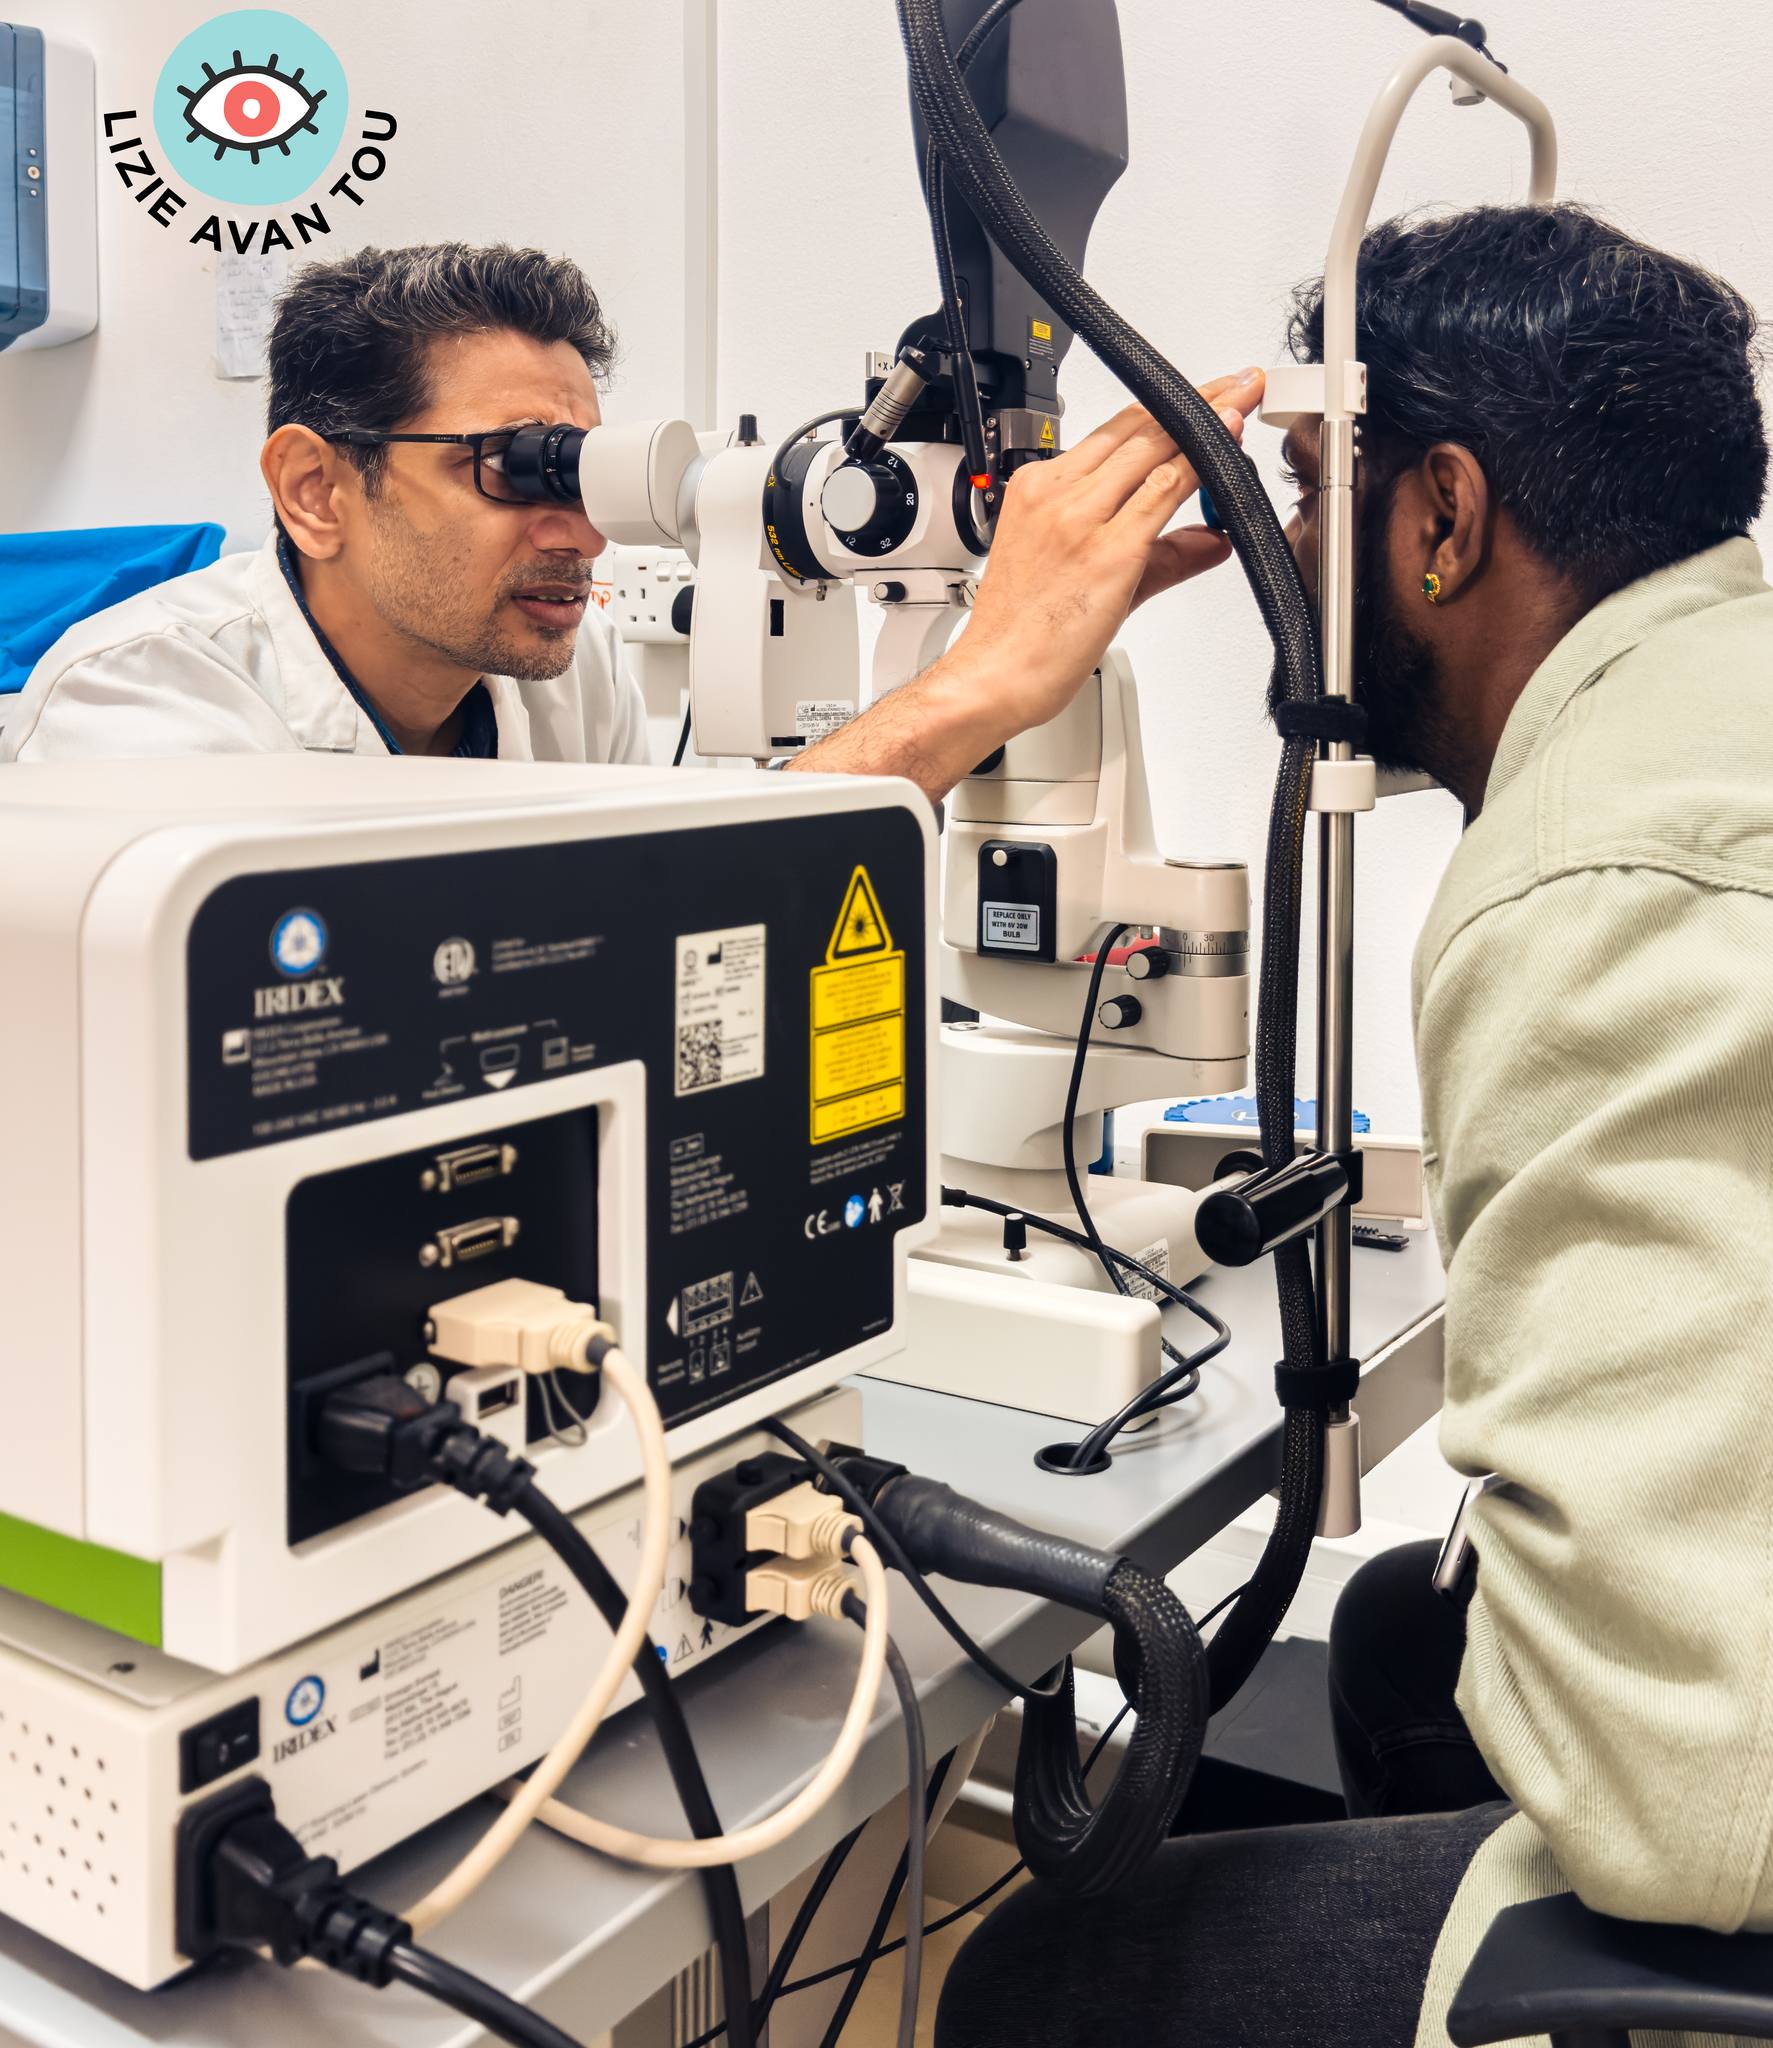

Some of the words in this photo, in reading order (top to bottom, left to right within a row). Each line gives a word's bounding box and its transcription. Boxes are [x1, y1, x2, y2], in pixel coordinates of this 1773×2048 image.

[887, 455, 899, 468] 12
[906, 492, 915, 506] 20
[767, 524, 779, 545] 532
[879, 537, 892, 549] 32
[993, 911, 1015, 919] REPLACE
[1003, 930, 1021, 938] BULB
[1203, 934, 1214, 942] 30
[254, 976, 345, 1019] IRIDEX
[273, 1713, 338, 1764] IRIDEX
